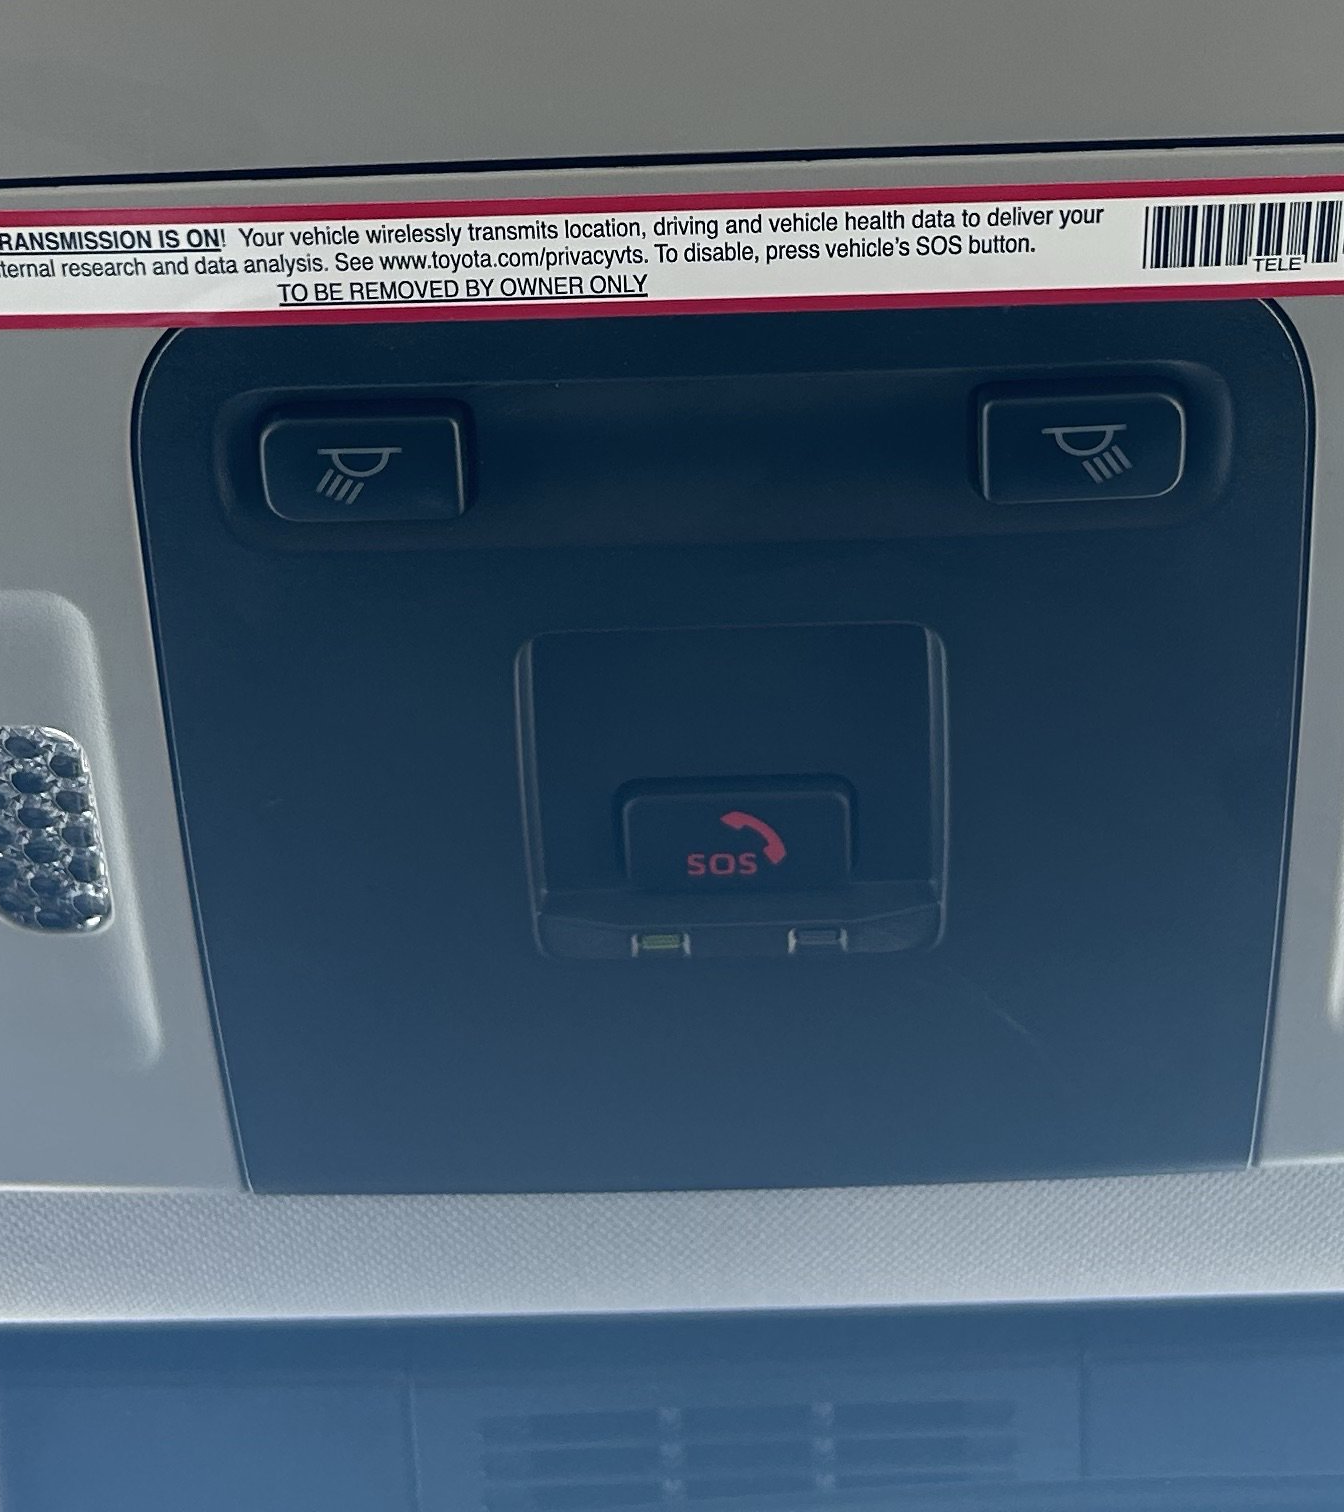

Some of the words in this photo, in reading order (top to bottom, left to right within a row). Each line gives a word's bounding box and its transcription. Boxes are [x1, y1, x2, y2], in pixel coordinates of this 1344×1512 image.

[159, 229, 175, 249] IS
[187, 228, 226, 249] ON!
[239, 228, 286, 247] Your
[290, 226, 359, 247] vehicle
[366, 223, 461, 249] wirelessly
[468, 220, 558, 242] transmits
[564, 219, 646, 242] location,
[654, 213, 718, 238] driving
[726, 214, 761, 234] and
[769, 211, 838, 233] vehicle
[845, 209, 905, 230] health
[912, 208, 954, 229] data
[962, 210, 980, 227] to
[987, 206, 1053, 227] deliver
[1059, 208, 1104, 229] your
[62, 256, 146, 277] research
[153, 255, 188, 275] and
[195, 254, 238, 274] data
[244, 252, 328, 277] analysis.
[335, 252, 374, 271] See
[658, 244, 678, 263] To
[684, 241, 759, 264] disable,
[766, 241, 819, 264] press
[917, 236, 962, 256] SOS
[968, 234, 1035, 255] button.
[1253, 257, 1302, 273] TELE
[278, 283, 307, 302] TO
[314, 283, 343, 302] BE
[351, 279, 458, 300] REMOVED
[466, 278, 494, 298] BY
[500, 277, 584, 297] OWNER
[590, 274, 647, 295] ONLY
[687, 852, 757, 875] SOS
